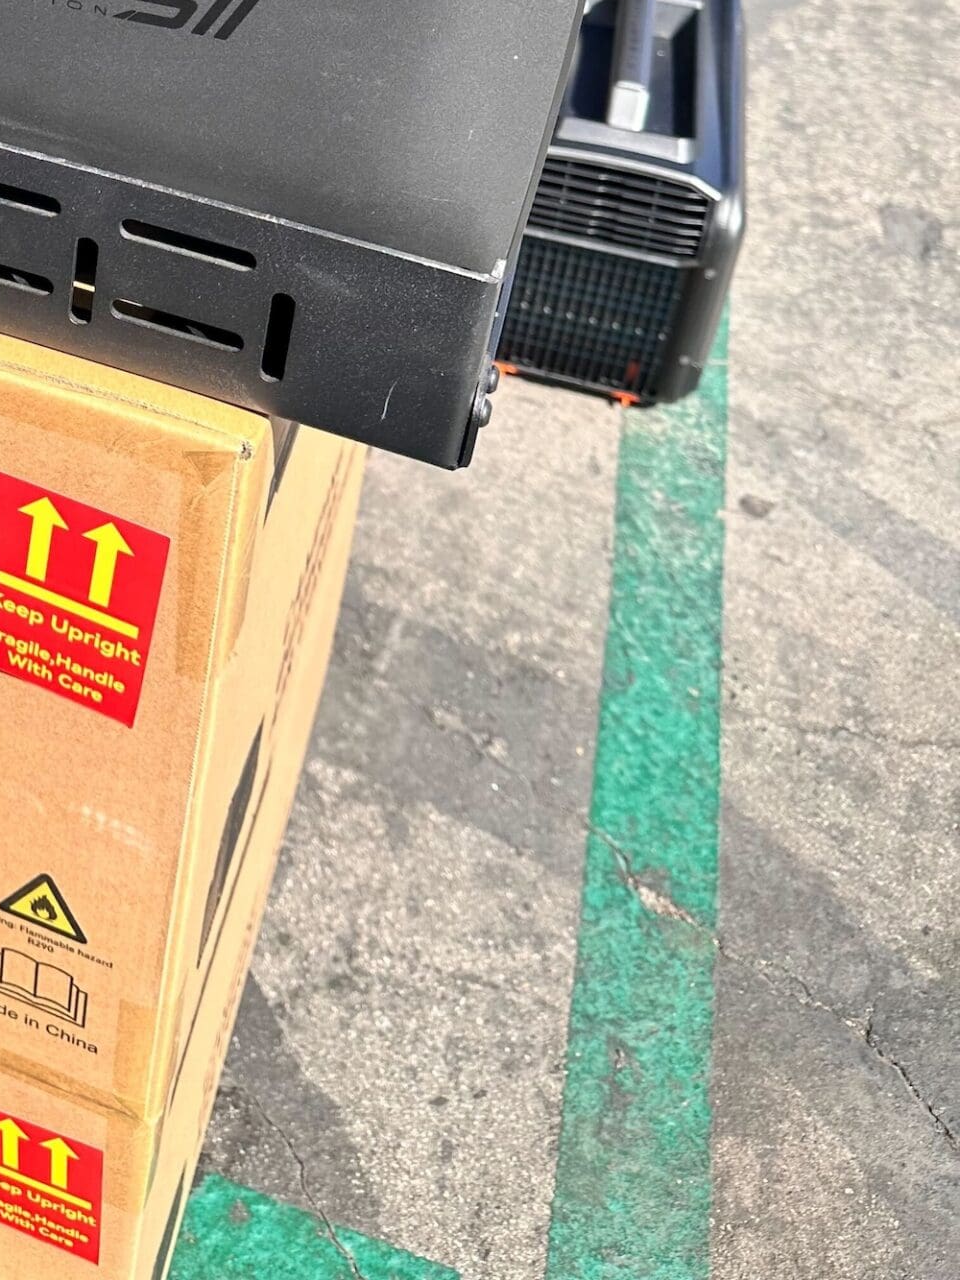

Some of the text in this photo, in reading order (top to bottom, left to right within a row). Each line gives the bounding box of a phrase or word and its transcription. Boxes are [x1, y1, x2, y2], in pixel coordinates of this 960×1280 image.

[50, 614, 142, 667] Upright
[7, 650, 104, 703] With Care
[19, 924, 75, 954] Flammable
[77, 948, 114, 969] hazard
[27, 937, 55, 953] R290
[24, 1013, 40, 1031] in
[45, 1023, 98, 1055] China
[26, 1189, 97, 1227] Upright
[39, 1226, 74, 1247] Care
